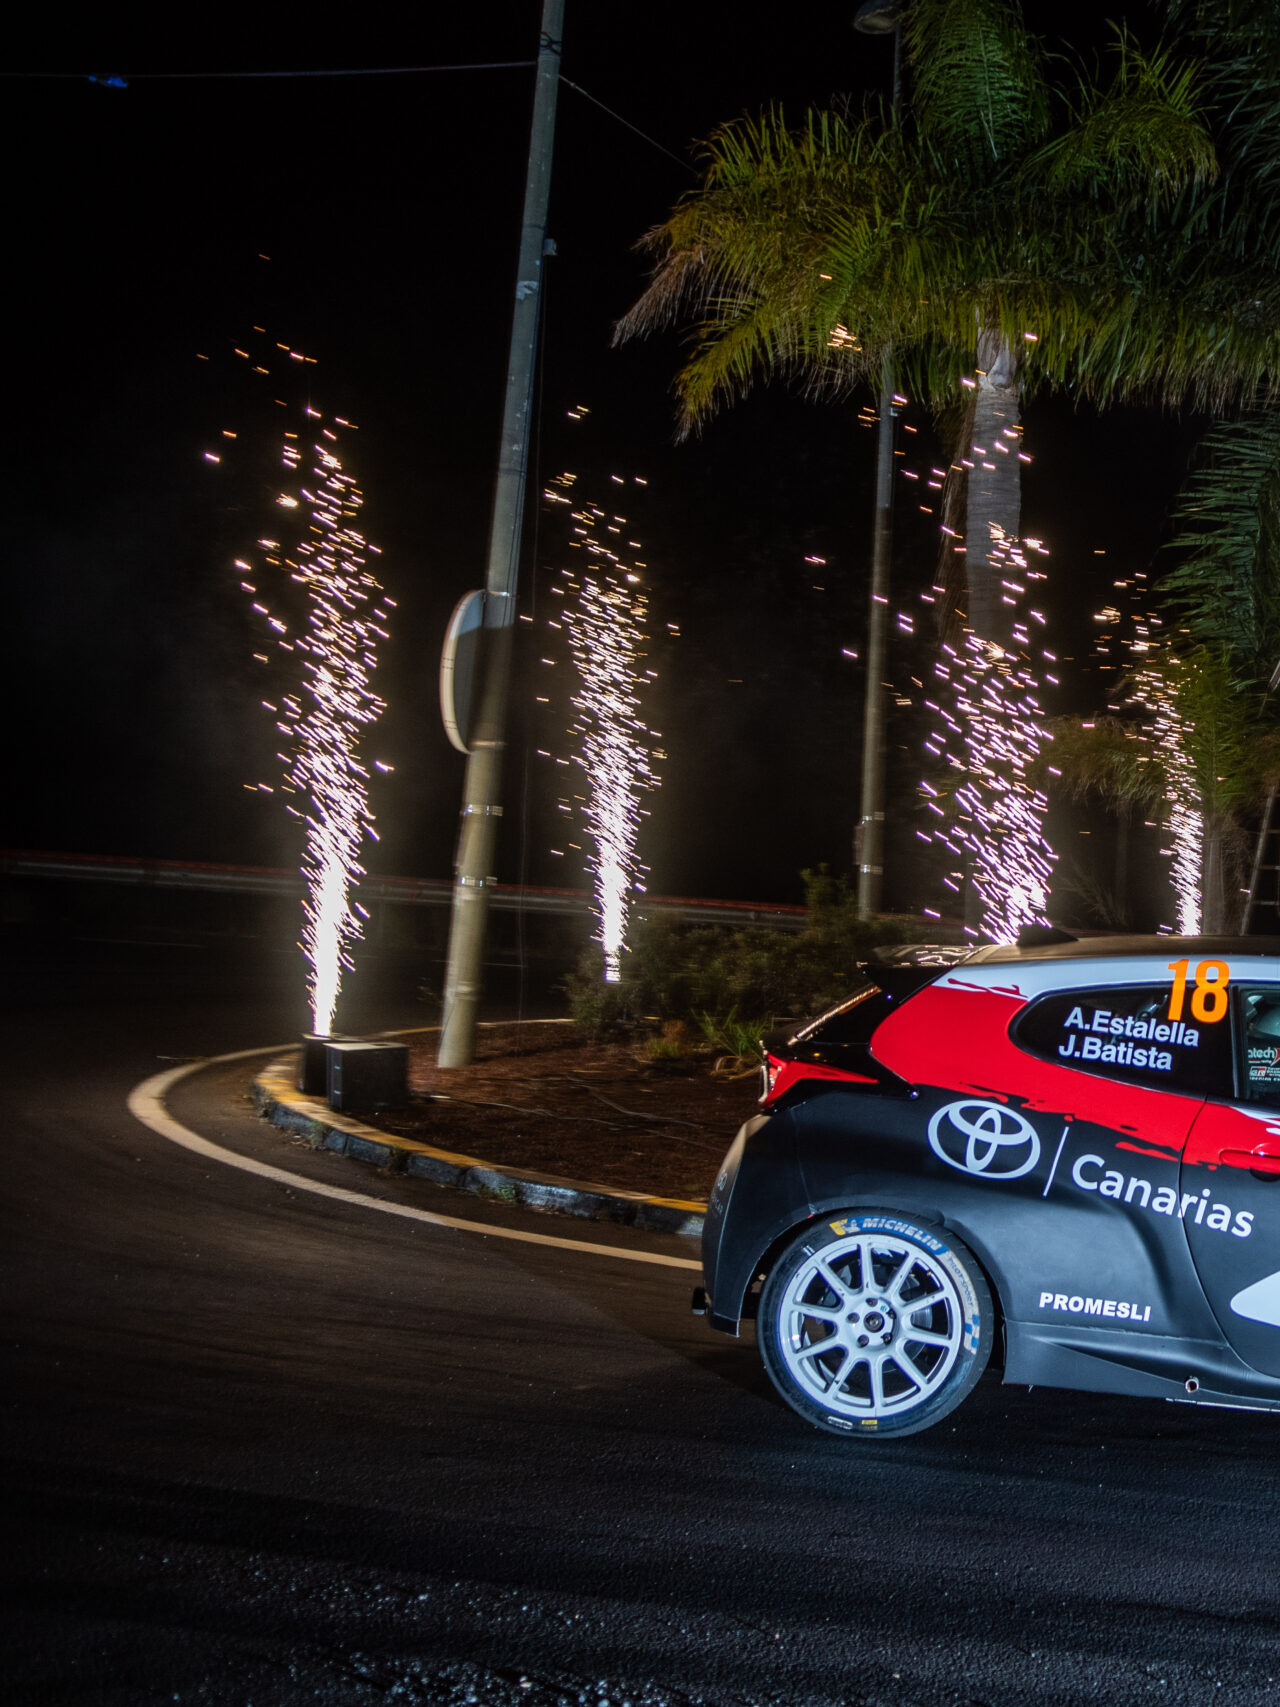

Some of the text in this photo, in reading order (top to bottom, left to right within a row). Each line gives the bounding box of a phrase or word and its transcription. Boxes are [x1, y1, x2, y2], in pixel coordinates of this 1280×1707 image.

[1168, 957, 1230, 1024] 18
[1064, 1006, 1199, 1048] A.Estalella
[1058, 1034, 1173, 1071] J.Batista
[1071, 1153, 1255, 1238] Canarias
[862, 1217, 943, 1251] MICHELIN
[1039, 1292, 1152, 1322] PROMESLI
